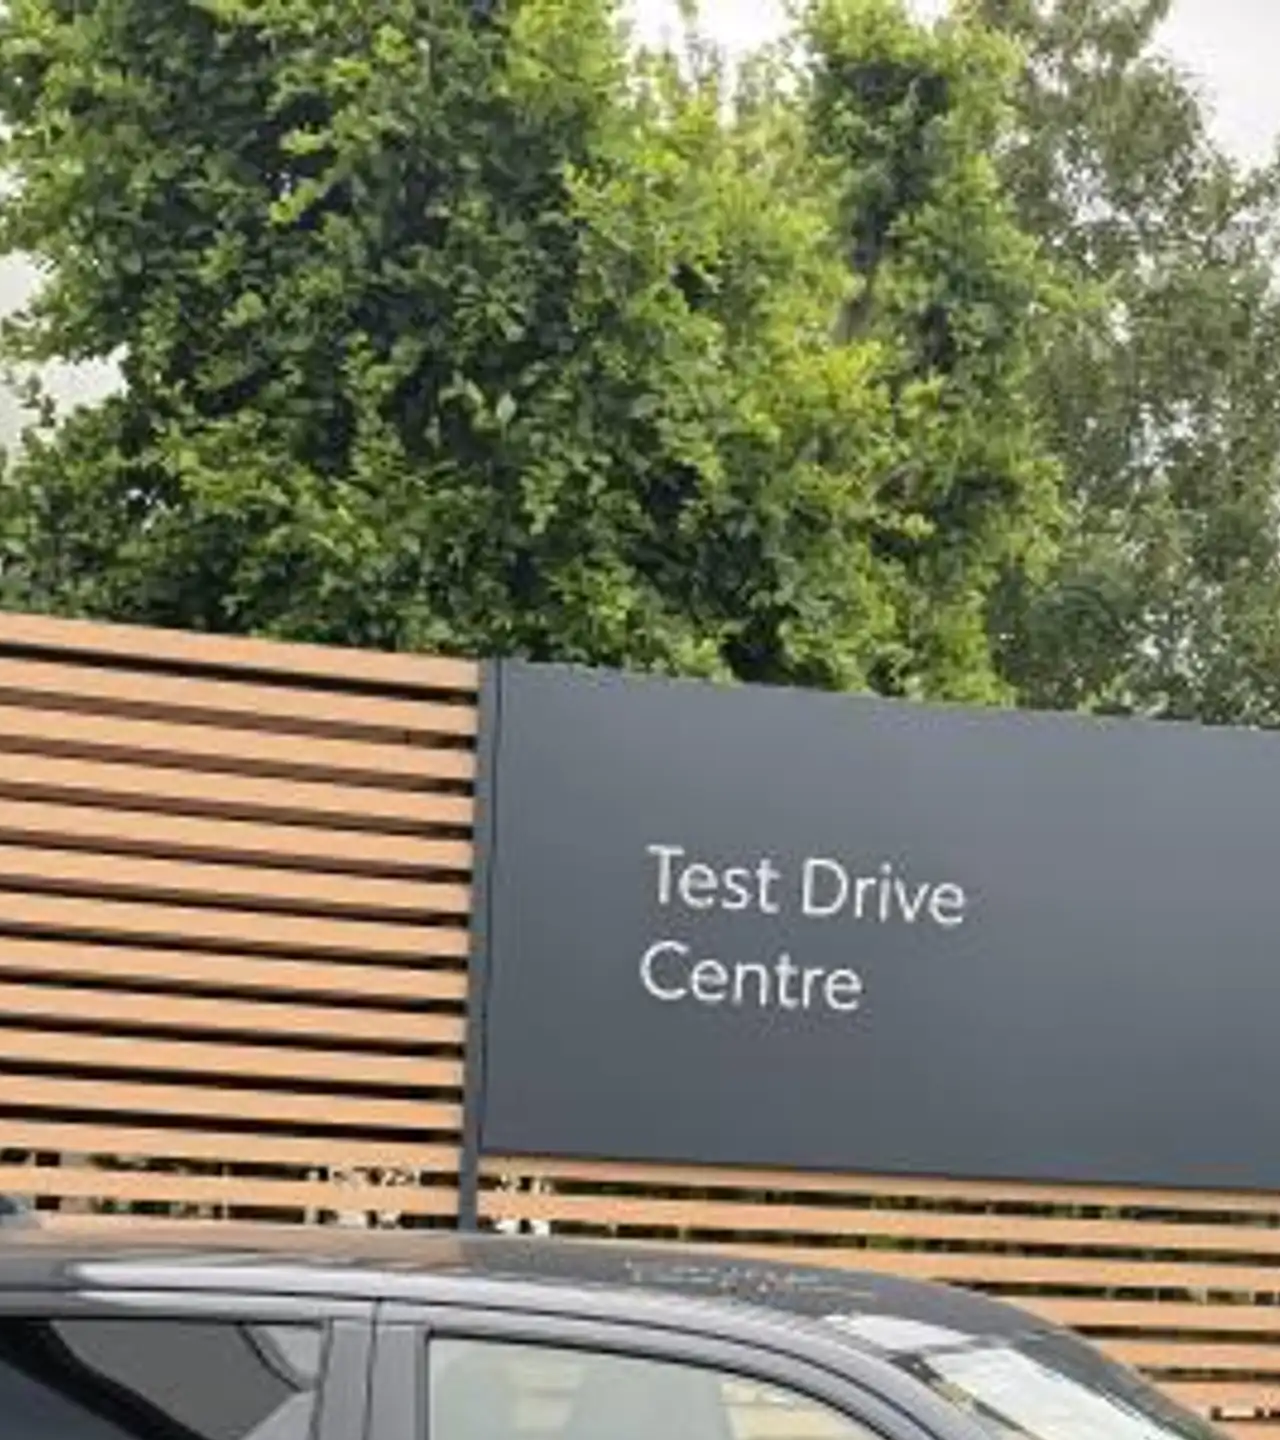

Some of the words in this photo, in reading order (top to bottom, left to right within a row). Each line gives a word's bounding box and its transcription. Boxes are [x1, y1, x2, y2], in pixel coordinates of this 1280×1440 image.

[646, 843, 781, 914] Test
[801, 857, 966, 926] Drive
[639, 939, 863, 1011] Centre
